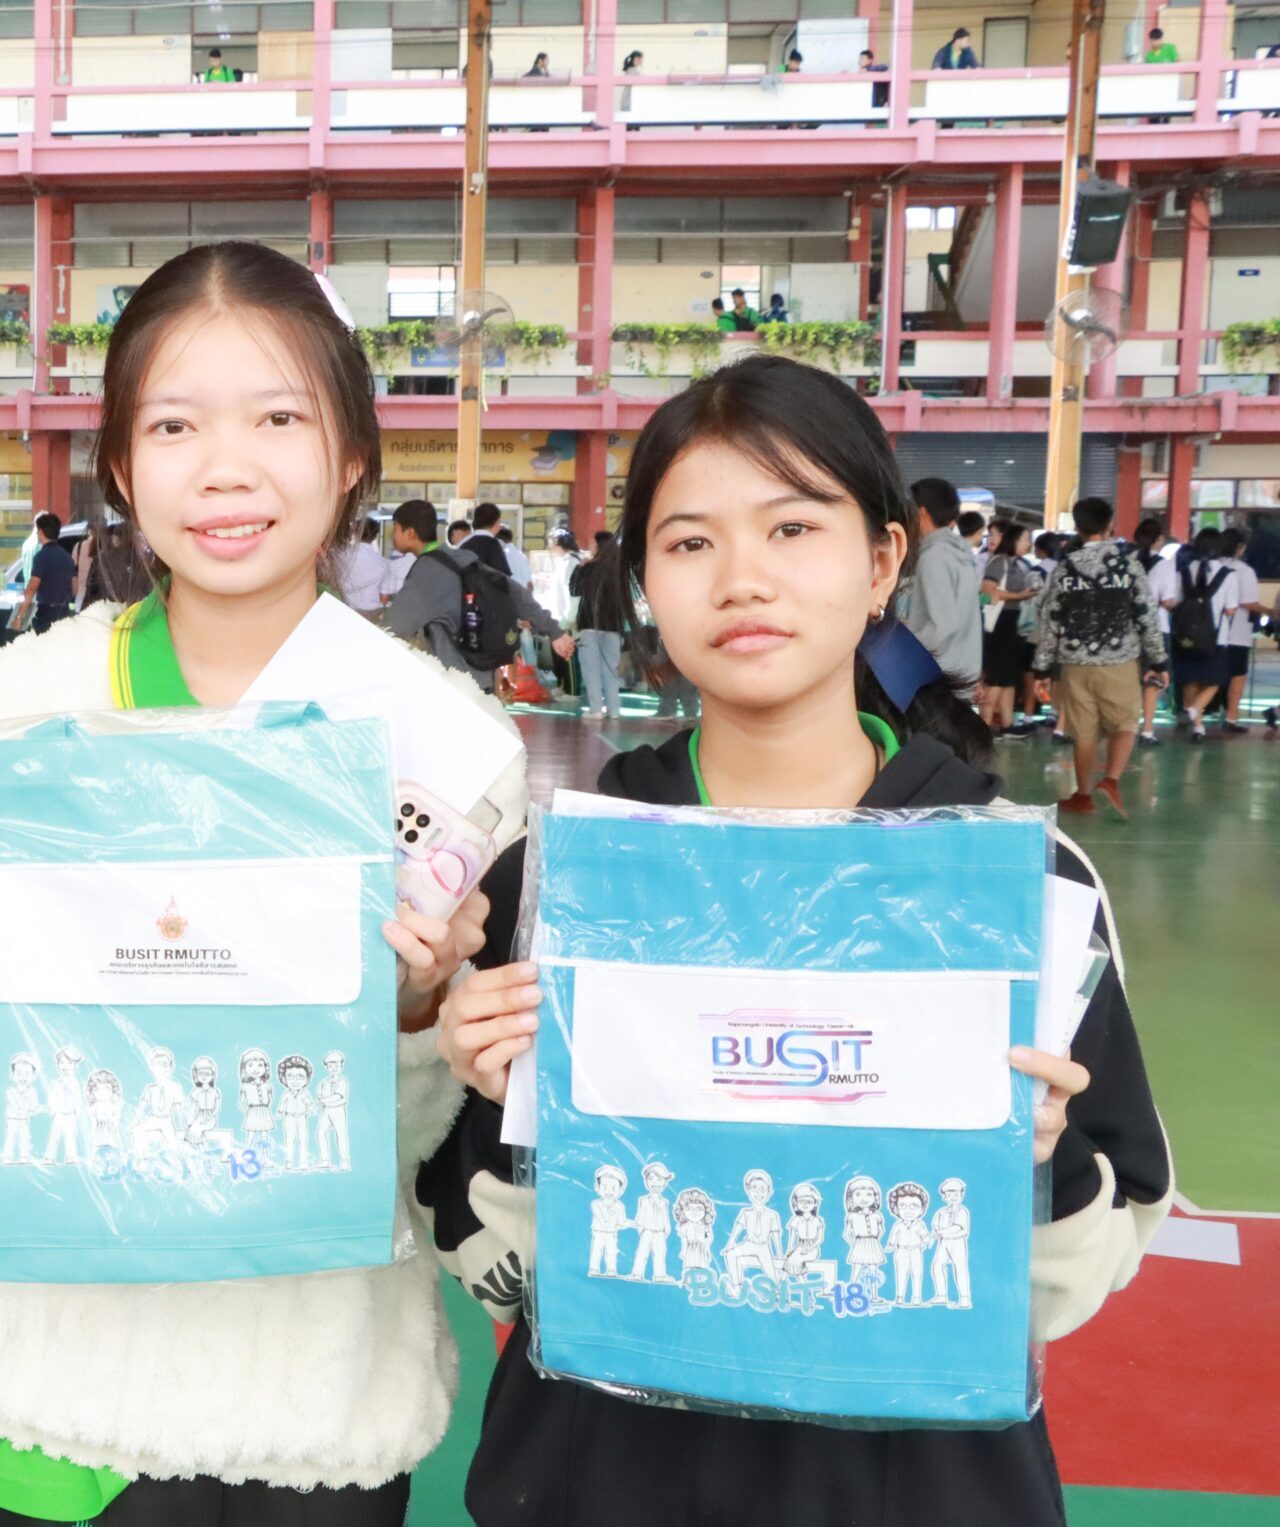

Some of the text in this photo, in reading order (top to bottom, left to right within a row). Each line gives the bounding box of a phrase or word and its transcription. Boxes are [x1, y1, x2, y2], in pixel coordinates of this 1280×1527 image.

[115, 948, 232, 960] BUSIT RMUTTO
[712, 1030, 874, 1087] BUSIT
[828, 1073, 880, 1085] RMUTTO
[686, 1268, 870, 1316] BUSIT 18
